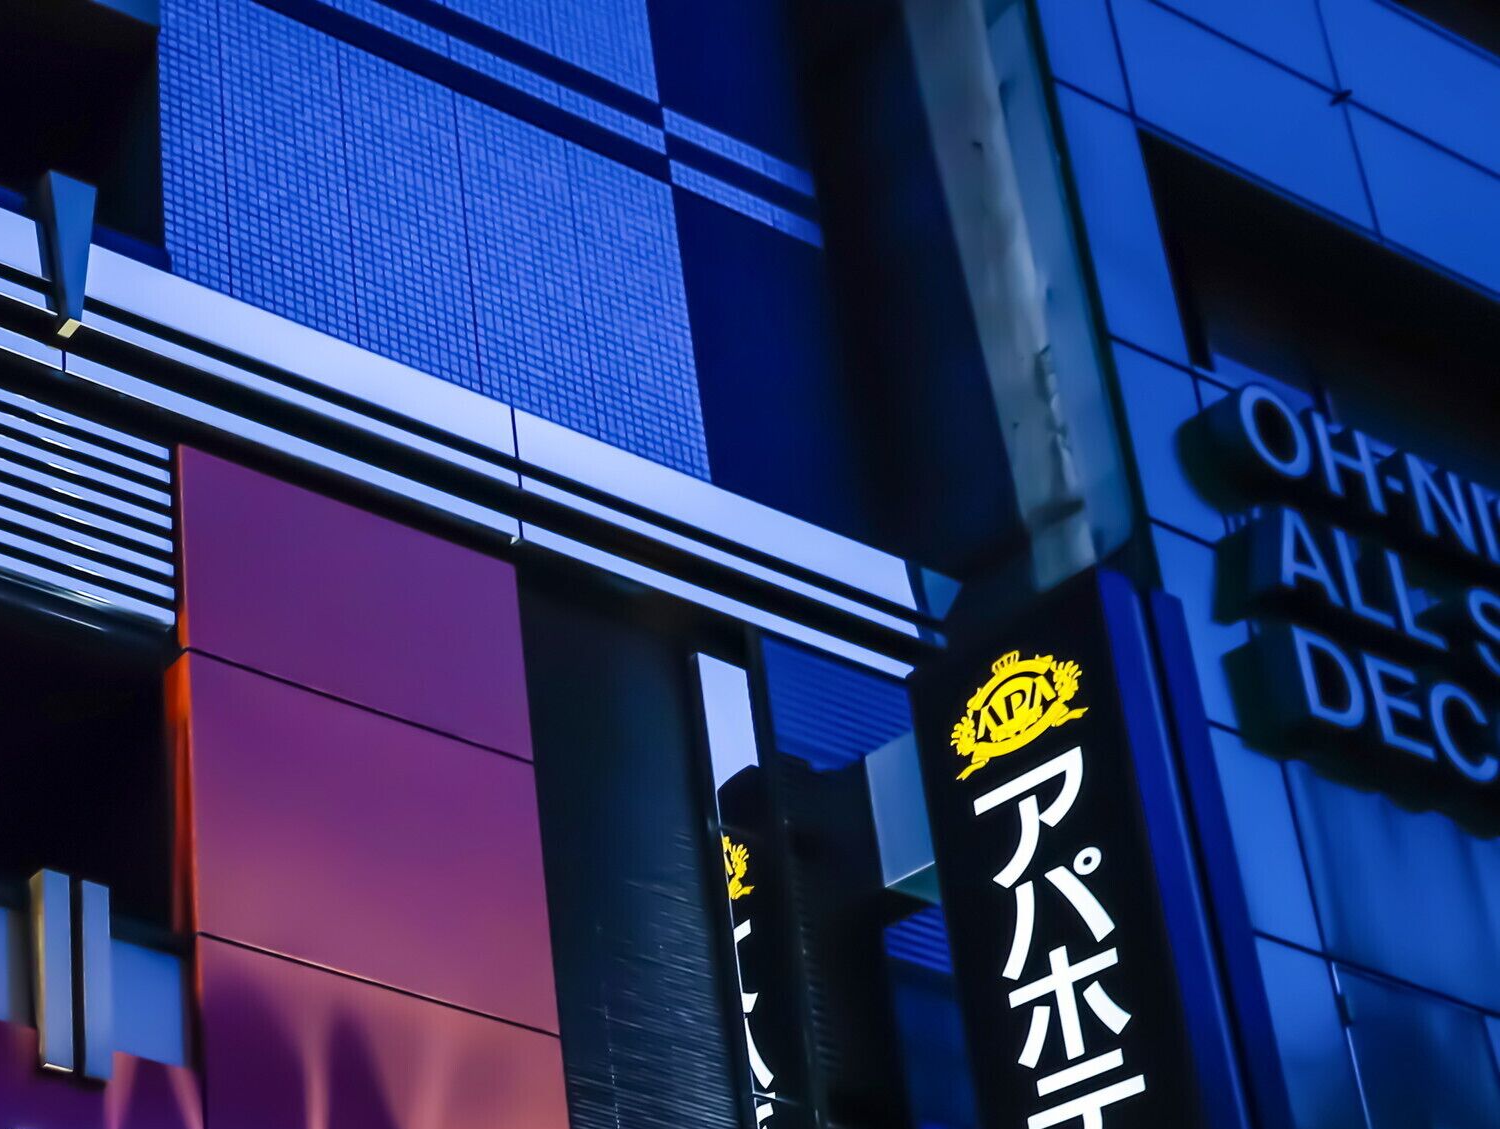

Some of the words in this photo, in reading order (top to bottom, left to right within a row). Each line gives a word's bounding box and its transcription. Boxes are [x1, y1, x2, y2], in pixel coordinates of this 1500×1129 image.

[1239, 382, 1500, 567] OH-NI
[1281, 507, 1449, 651] ALL
[977, 674, 1057, 740] APA
[1291, 624, 1500, 783] DEC
